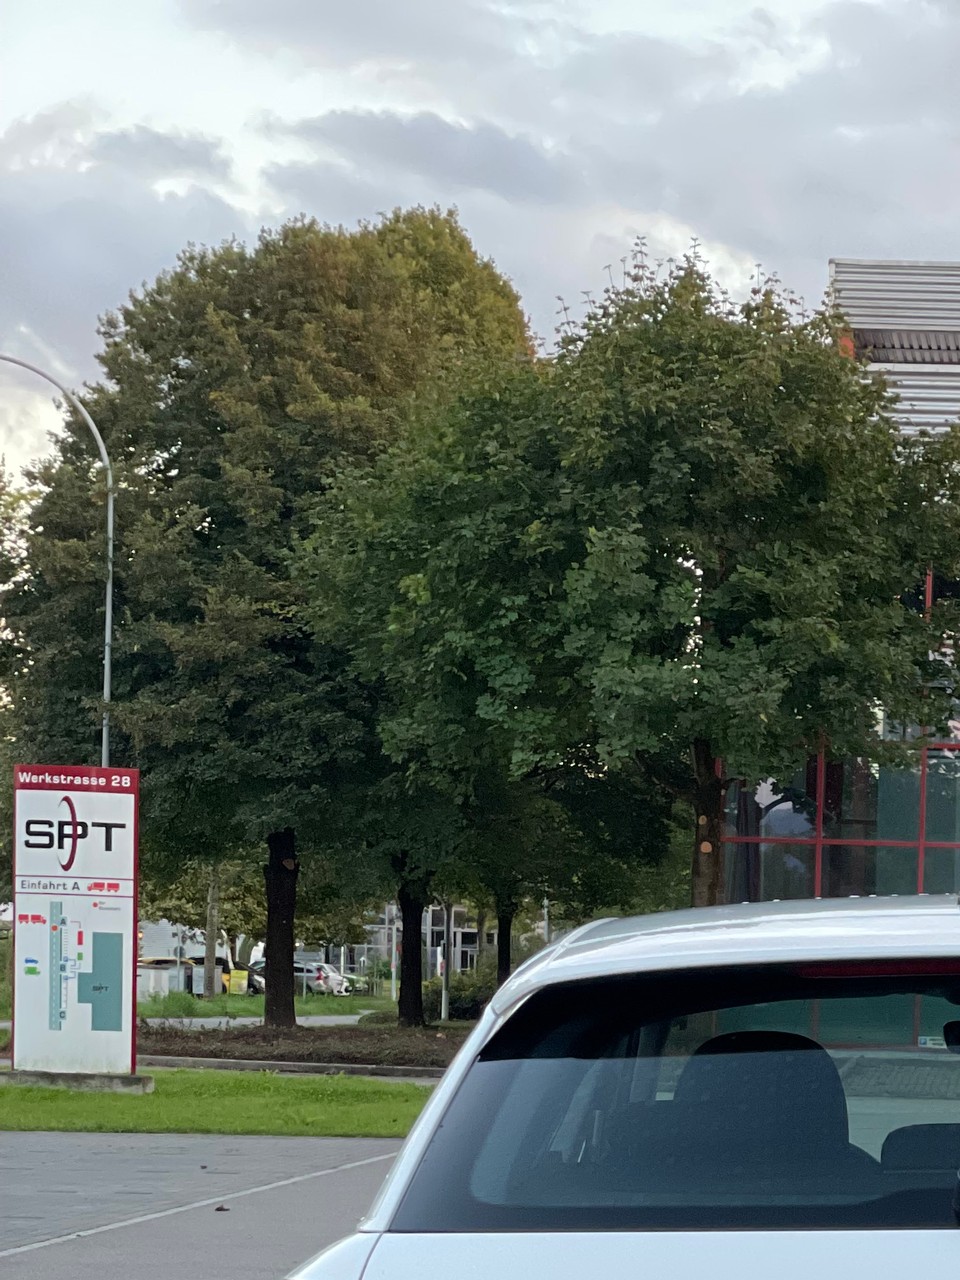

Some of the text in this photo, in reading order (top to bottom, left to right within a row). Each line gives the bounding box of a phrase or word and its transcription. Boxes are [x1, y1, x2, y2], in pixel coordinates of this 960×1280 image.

[18, 771, 131, 787] Werkstrasse 28
[24, 819, 127, 852] SPT
[20, 880, 81, 891] Einfahrt A
[60, 918, 67, 926] A
